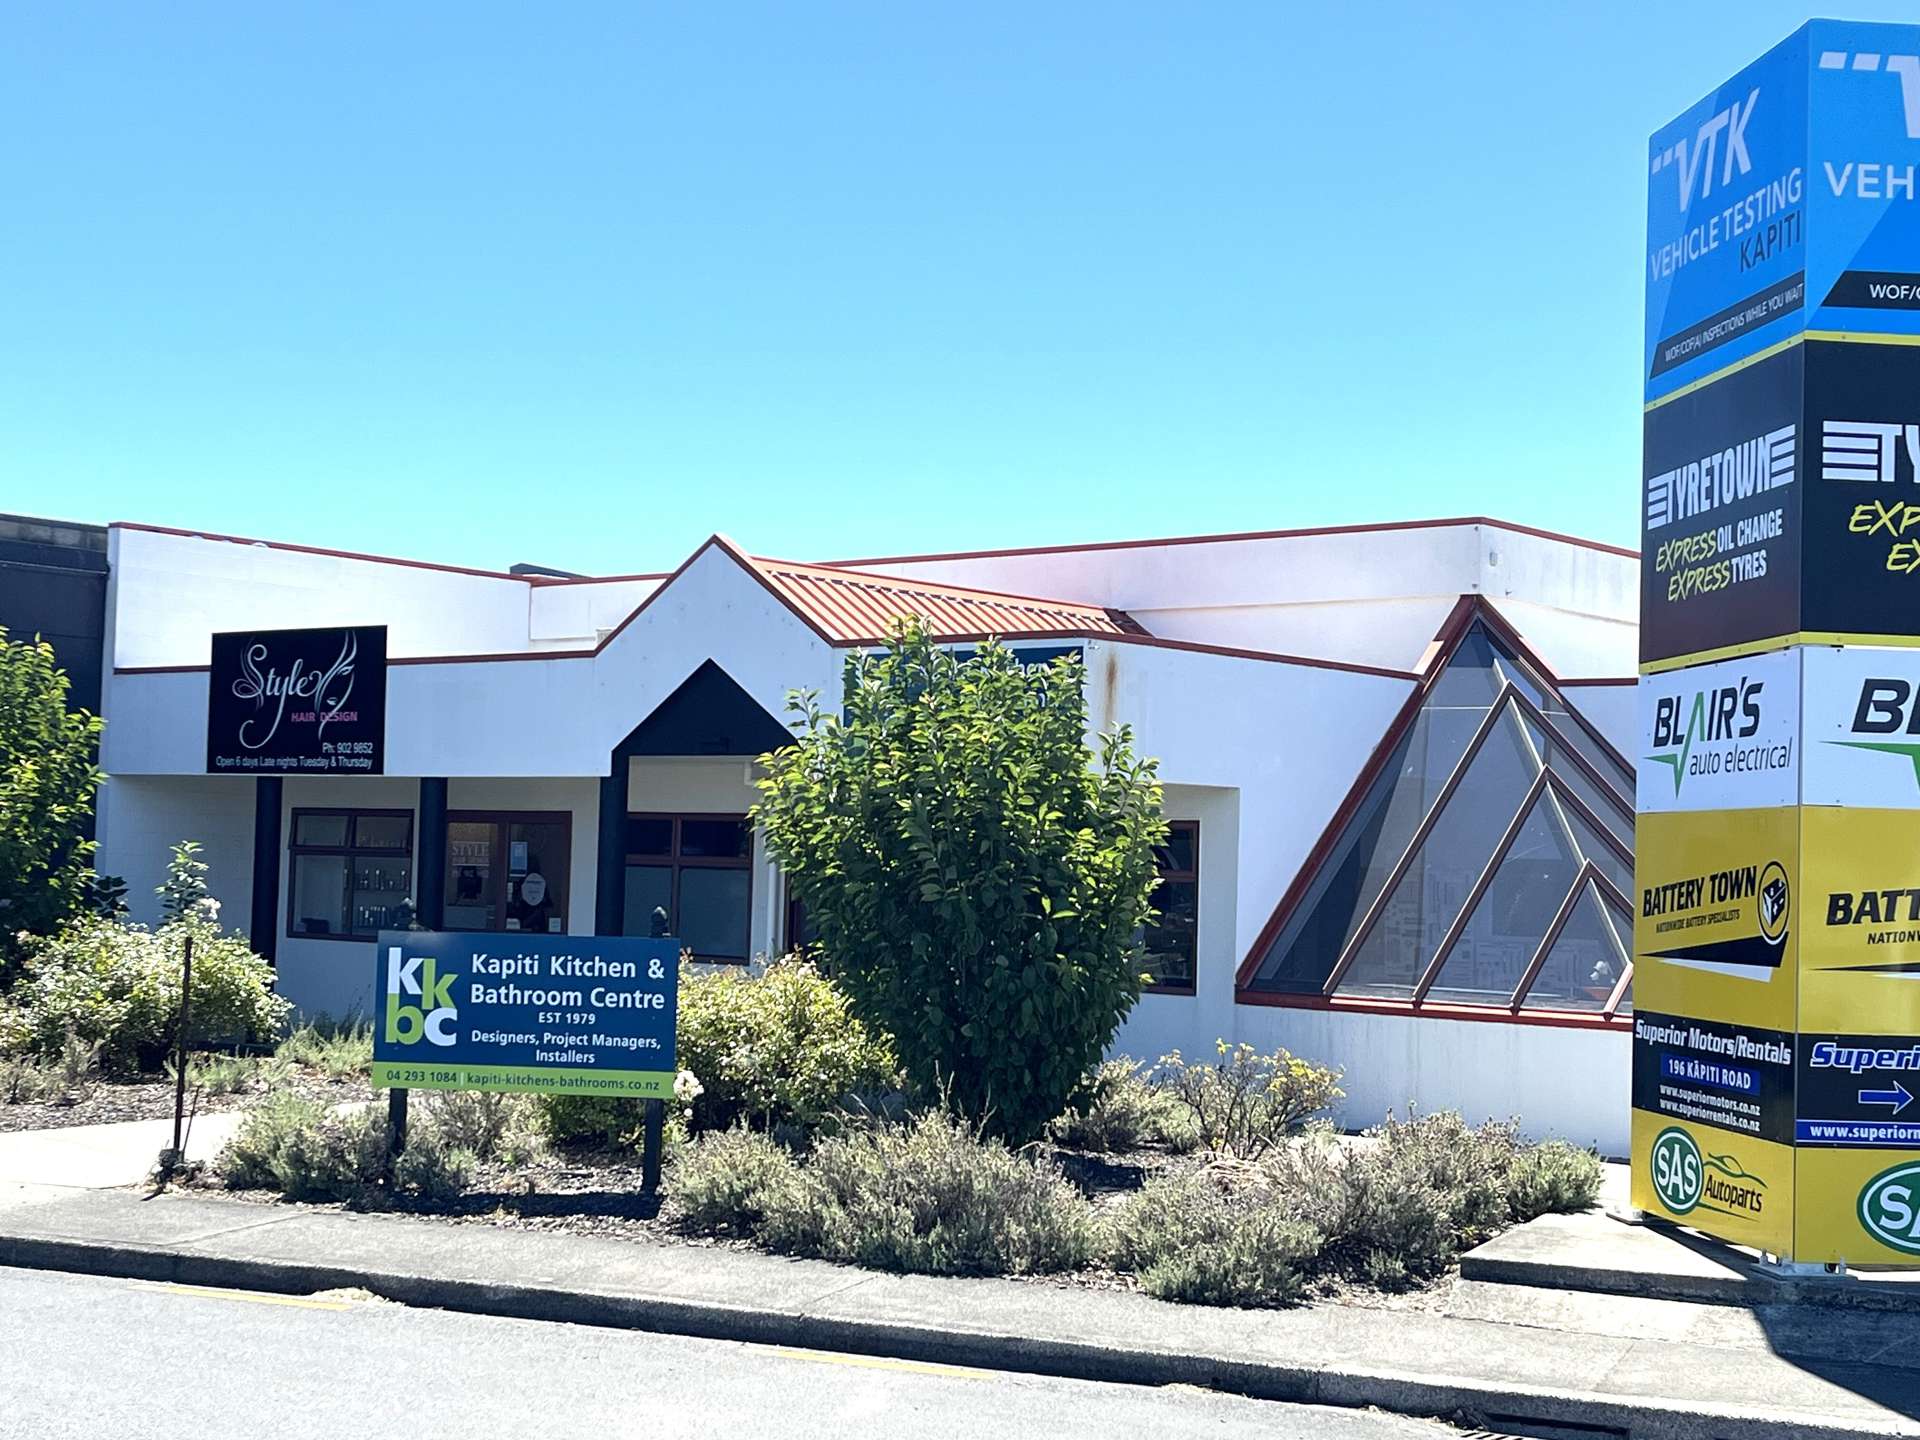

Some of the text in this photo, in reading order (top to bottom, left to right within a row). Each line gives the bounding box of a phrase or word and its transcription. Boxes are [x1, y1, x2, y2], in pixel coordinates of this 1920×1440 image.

[1674, 86, 1760, 213] VTK
[1823, 161, 1914, 200] VEH
[1651, 167, 1801, 281] VEHICLE TESTING
[1740, 209, 1800, 273] KAPITI
[1702, 311, 1745, 345] INSPECTIONS
[1745, 300, 1767, 323] WHILE
[1767, 292, 1784, 312] YOU
[1784, 283, 1804, 304] WAIT
[1648, 424, 1796, 530] TYRETOWN
[1655, 508, 1783, 573] EXPRESS OIL CHANGE
[1668, 549, 1767, 603] EXPRESS TYRES
[232, 644, 322, 749] Style
[1653, 676, 1764, 748] BLAIR'S
[291, 711, 358, 722] HAIR DESIGN
[216, 756, 235, 768] Open
[242, 756, 258, 768] days
[259, 756, 275, 766] Late
[276, 756, 298, 769] nights
[299, 756, 329, 769] Tuesday
[330, 756, 337, 767] &
[338, 756, 373, 769] Thursday
[1690, 736, 1793, 775] auto electrical
[1642, 865, 1757, 917] BATTERY TOWN
[1685, 914, 1707, 928] BATTERY
[1707, 909, 1741, 924] SPECIALISTS
[471, 953, 665, 979] Kapiti Kitchen &
[470, 984, 665, 1009] Bathroom Centre
[538, 1012, 596, 1025] EST 1979
[471, 1030, 661, 1050] Designers, Project Managers,
[535, 1049, 595, 1064] Installers
[1635, 1019, 1792, 1065] Superior Motors/Rentals
[386, 1070, 660, 1091] 04 293 1084 kapiti-kitchens-bathrooms.co.nz
[1668, 1059, 1751, 1089] 196 KĀPITI ROAD
[1659, 1084, 1760, 1116] www.superiormotors.co.nz
[1659, 1099, 1760, 1132] www.superiorrentals.co.nz
[1657, 1143, 1697, 1200] SAS
[1704, 1174, 1762, 1212] Autoparts
